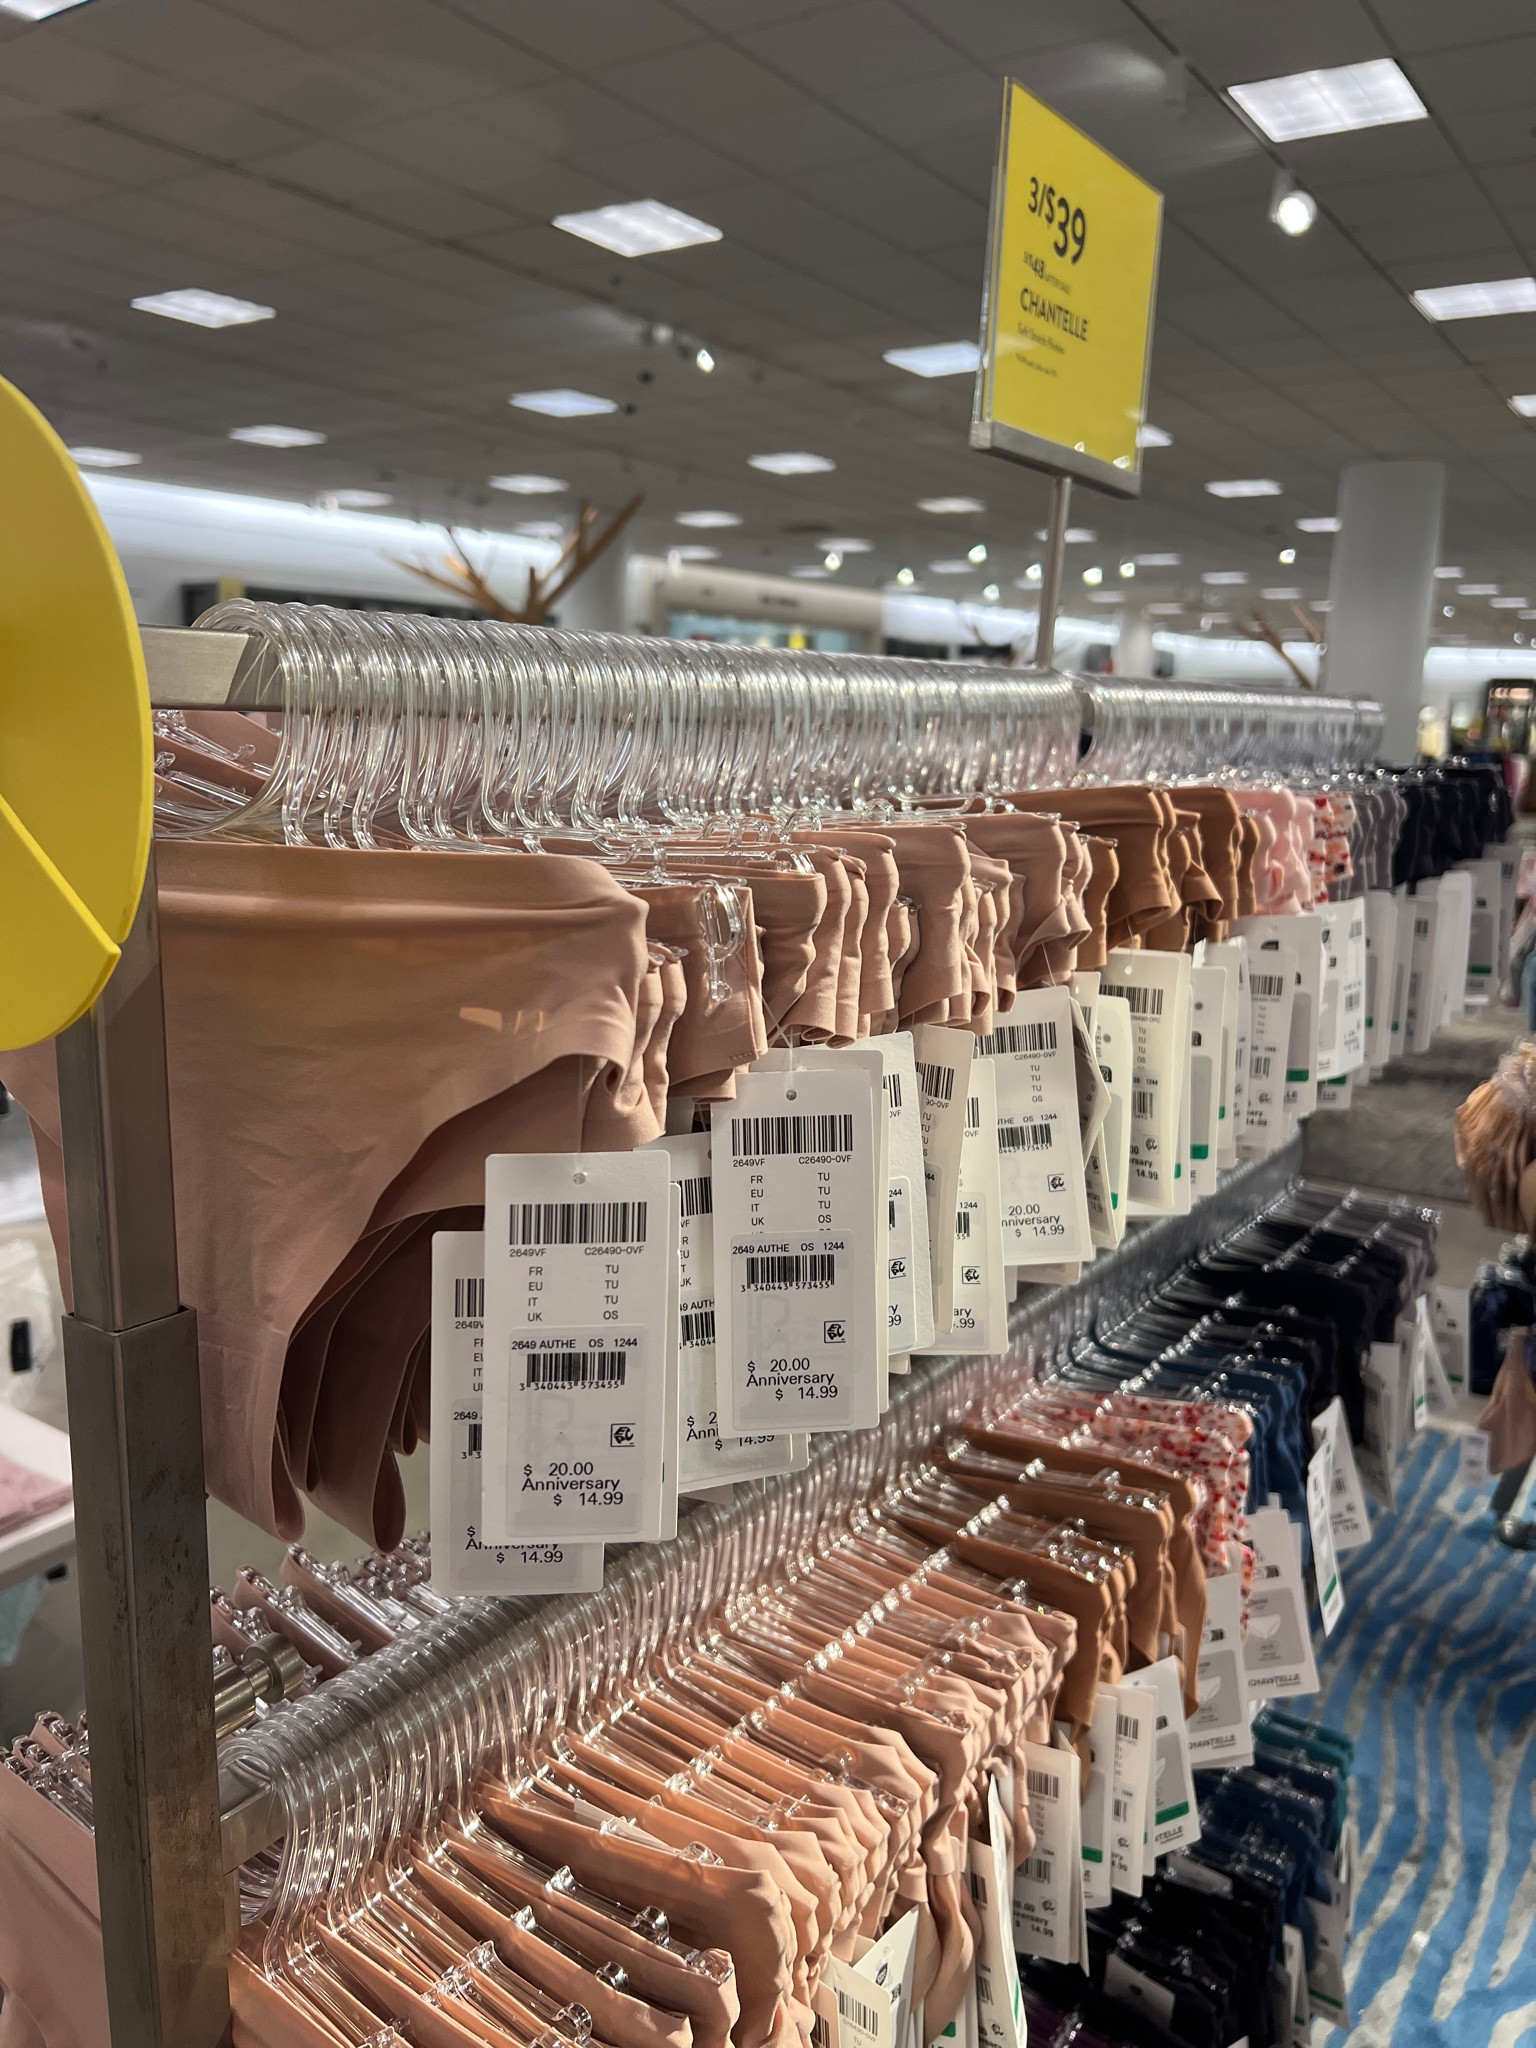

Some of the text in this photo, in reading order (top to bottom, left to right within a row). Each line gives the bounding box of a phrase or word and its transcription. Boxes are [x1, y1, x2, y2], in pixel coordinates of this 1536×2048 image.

[1020, 287, 1088, 341] CHANTELLE
[1014, 1051, 1056, 1060] C26490-0VF
[1023, 1115, 1034, 1123] OS
[1040, 1113, 1057, 1121] 1244
[732, 1154, 852, 1167] 2649VF C26490-0VF
[750, 1172, 831, 1184] FR TU
[1136, 1168, 1158, 1180] 14.99
[751, 1186, 831, 1198] EU TU
[751, 1200, 831, 1212] IT TU
[960, 1201, 978, 1209] 1244
[1008, 1204, 1040, 1216] 20.00
[751, 1214, 832, 1226] UK OS
[1015, 1224, 1065, 1238] $ 14.99
[509, 1246, 645, 1258] 2649VF C26490-0VF
[732, 1241, 845, 1255] 2649 AUTHE OS 1244
[528, 1264, 619, 1276] FR TU
[528, 1280, 619, 1291] EU TU
[741, 1281, 830, 1292] 3 340443 573455
[528, 1295, 618, 1307] IT TU
[527, 1310, 619, 1322] UK OS
[511, 1337, 638, 1350] 2649 AUTHE OS 1244
[747, 1357, 810, 1374] $ 20.00
[519, 1380, 619, 1391] 3 340443 573455
[746, 1373, 835, 1388] Anniversary
[473, 1382, 483, 1392] U
[775, 1385, 838, 1401] $ 14.99
[453, 1411, 478, 1421] 2649
[687, 1415, 695, 1428] $
[715, 1438, 723, 1451] $
[523, 1461, 594, 1477] $ 20.00
[521, 1477, 621, 1492] Anniversary
[553, 1492, 624, 1507] $ 14.99
[467, 1525, 475, 1538] $
[496, 1550, 563, 1564] $ 14.99
